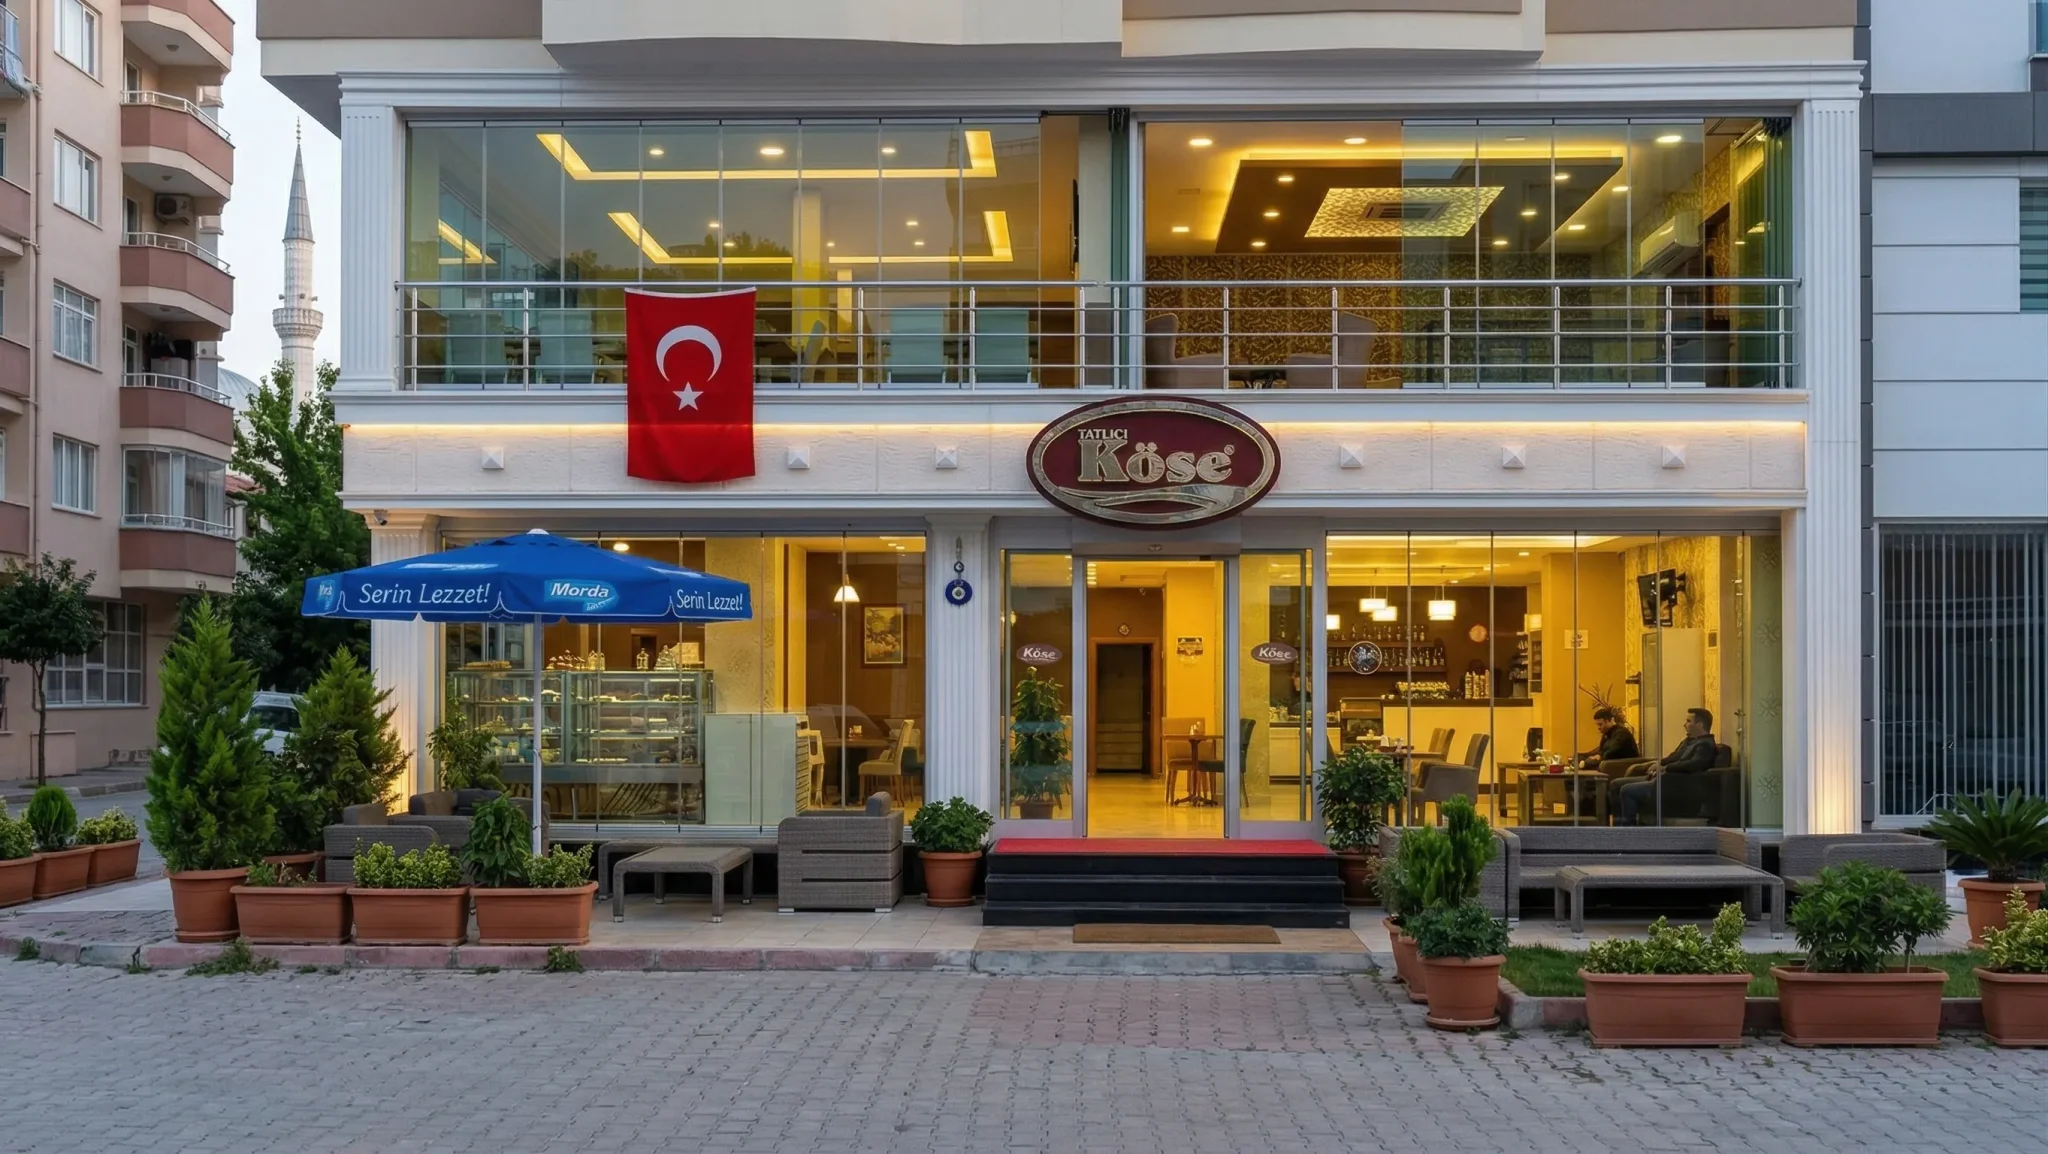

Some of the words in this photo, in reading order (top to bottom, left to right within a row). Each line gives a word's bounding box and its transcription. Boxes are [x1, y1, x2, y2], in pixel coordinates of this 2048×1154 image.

[1078, 429, 1128, 440] TATLICI
[1078, 440, 1233, 483] Köse
[359, 583, 412, 604] Serin
[419, 583, 491, 604] Lezzet!
[551, 583, 609, 598] Morda
[676, 588, 706, 610] Serin
[707, 591, 743, 611] Lezzet!
[1023, 647, 1056, 660] Köse
